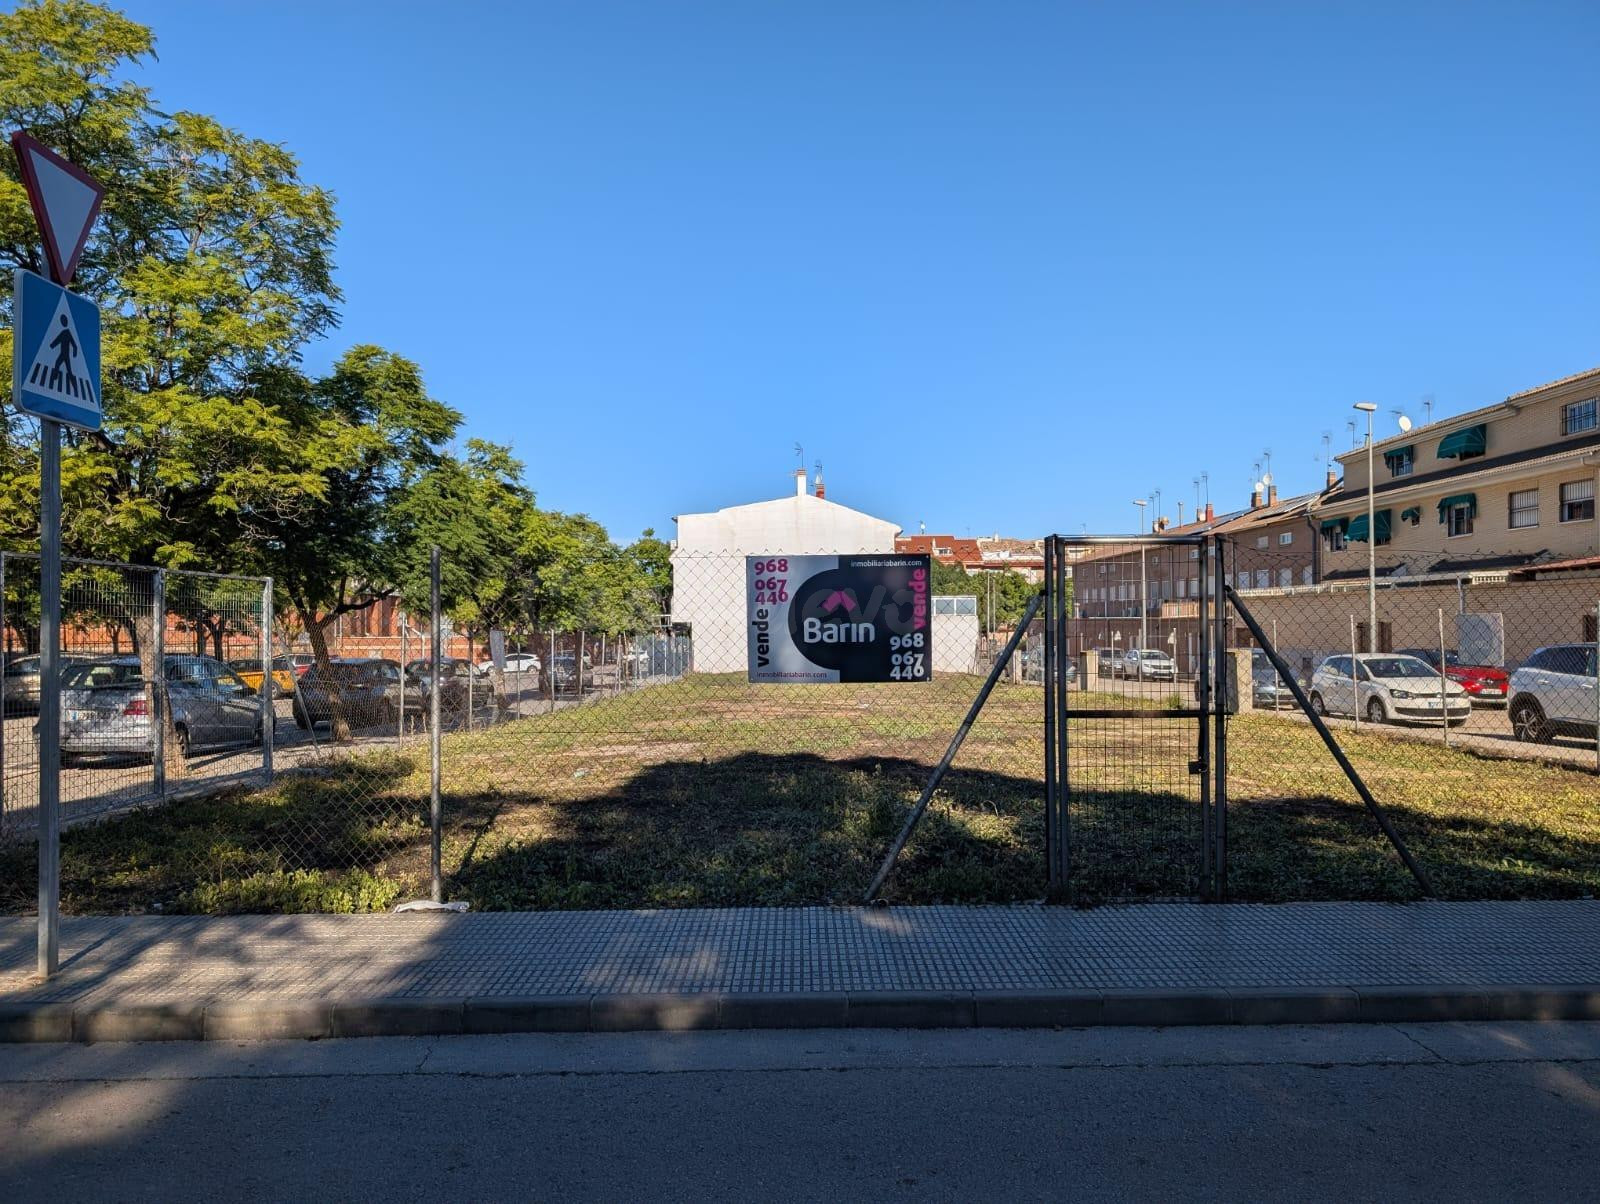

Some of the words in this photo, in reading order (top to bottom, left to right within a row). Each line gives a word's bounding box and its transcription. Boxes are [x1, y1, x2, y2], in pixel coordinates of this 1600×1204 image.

[754, 559, 788, 575] 968
[755, 577, 787, 593] 067
[908, 568, 927, 629] vende
[752, 608, 769, 668] vende
[803, 617, 875, 643] Barin
[890, 633, 924, 650] 968
[891, 651, 924, 668] 067
